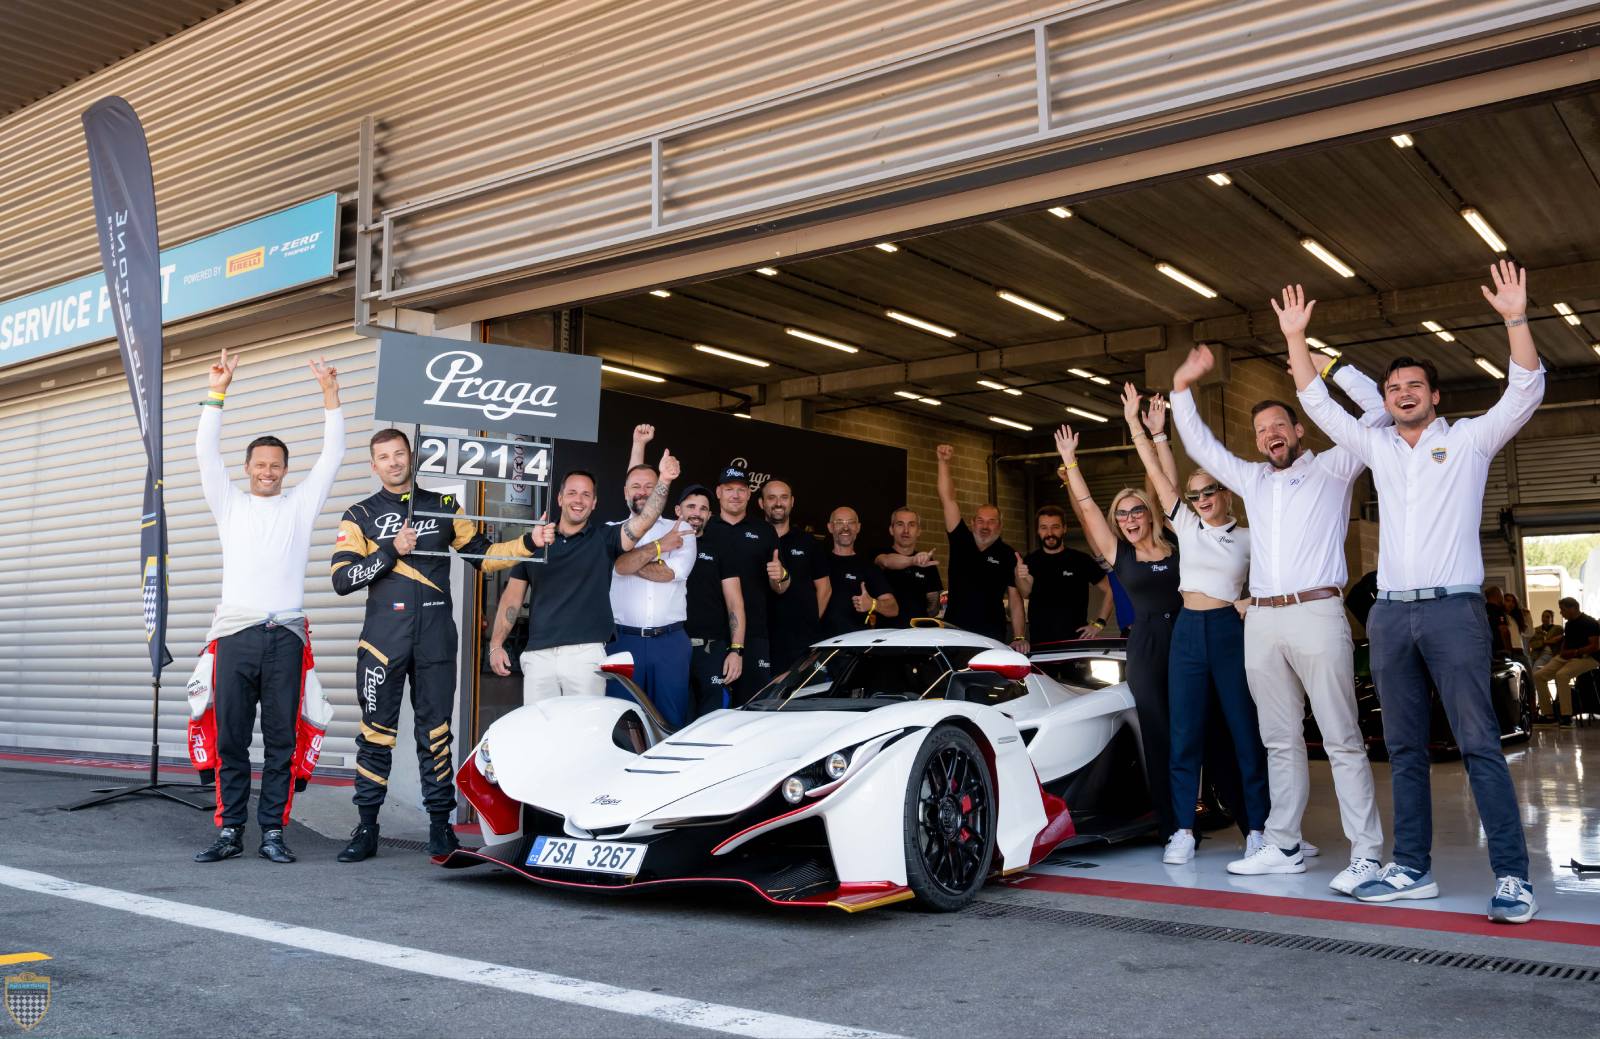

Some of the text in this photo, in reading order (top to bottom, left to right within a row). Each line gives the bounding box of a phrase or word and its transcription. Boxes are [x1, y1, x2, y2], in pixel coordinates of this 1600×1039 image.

[269, 231, 321, 256] P ZERO
[183, 265, 222, 285] POWERED BY
[230, 251, 261, 274] PIRELLI
[0, 290, 92, 351] SERVICE
[424, 350, 558, 421] Praga
[374, 512, 440, 540] Prga
[362, 666, 386, 714] Praga
[541, 841, 637, 870] 7SA 3267
